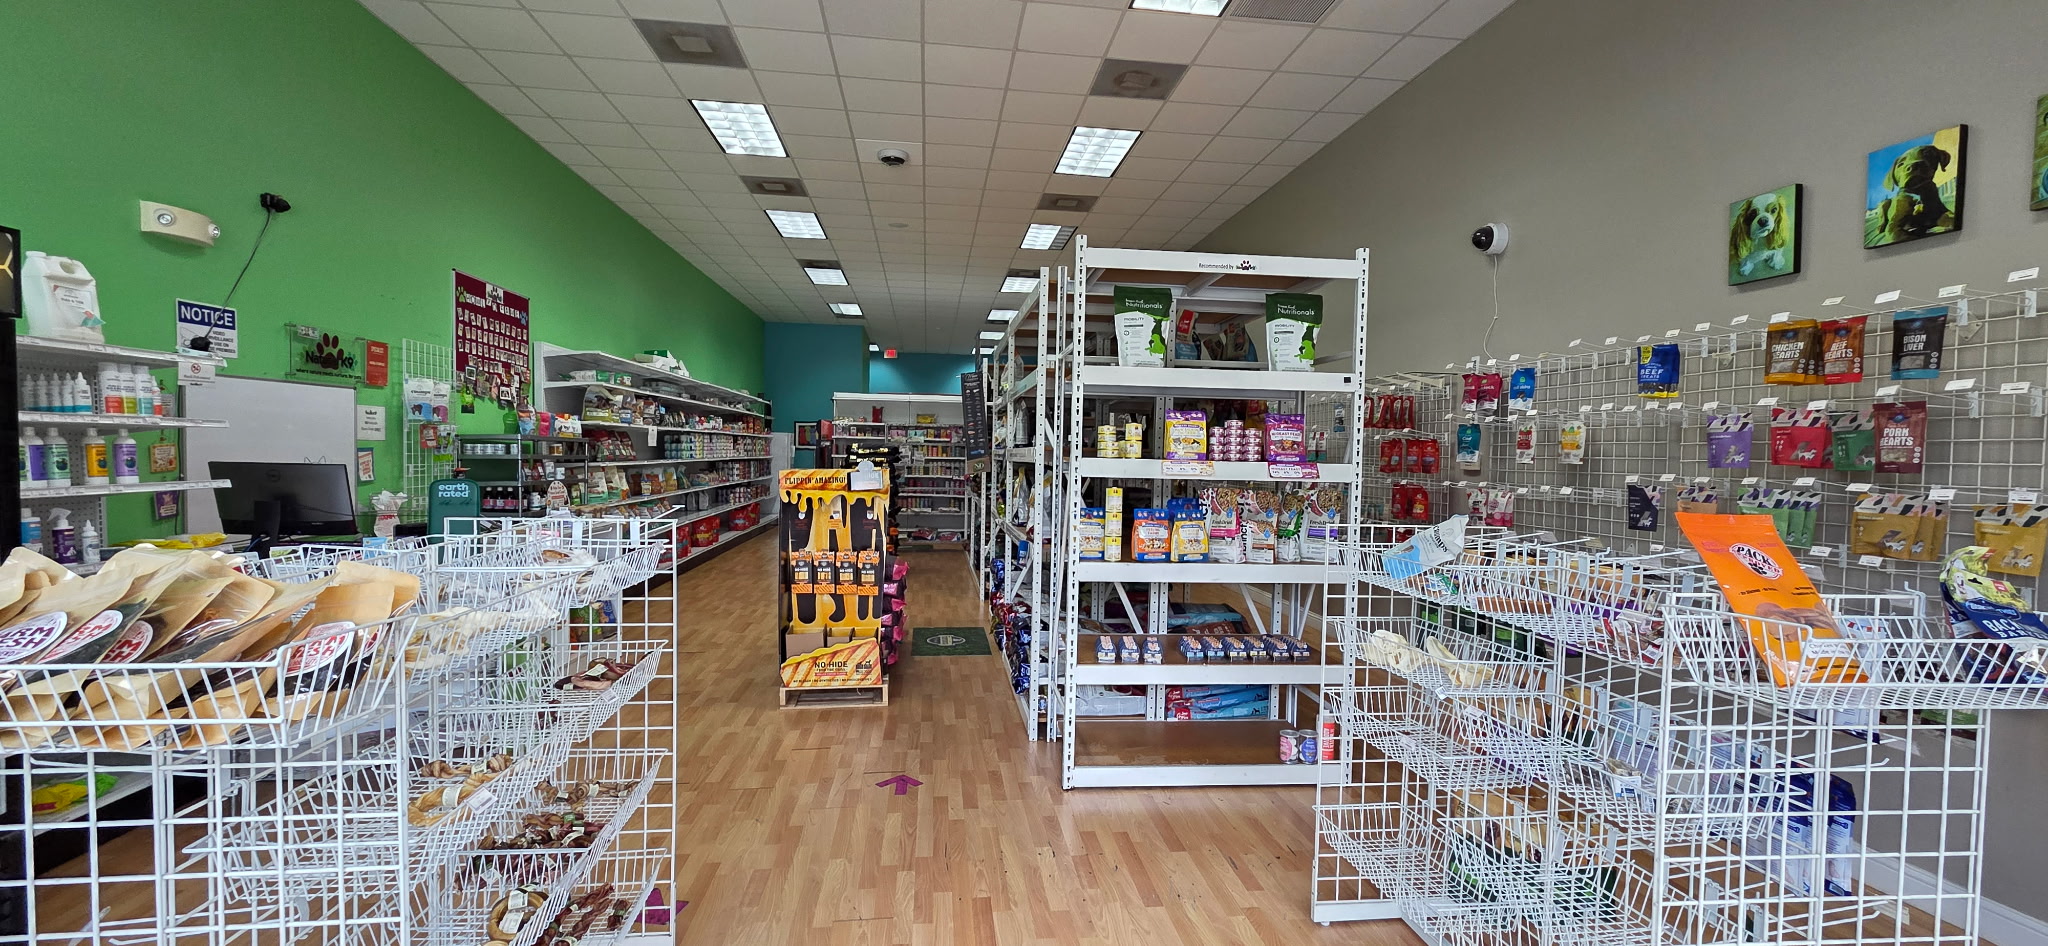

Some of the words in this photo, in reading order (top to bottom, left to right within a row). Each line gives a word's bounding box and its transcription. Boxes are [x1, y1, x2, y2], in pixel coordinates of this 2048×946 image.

[181, 305, 233, 326] NOTICE
[1277, 307, 1315, 316] Nutritionals
[1903, 333, 1926, 344] BISON
[1771, 341, 1805, 353] CHICKEN
[1830, 340, 1848, 352] BEEF
[1903, 341, 1924, 352] LIVER
[1824, 348, 1853, 360] HEARTS
[1883, 427, 1909, 438] PORK
[1879, 436, 1914, 448] HEARTS
[438, 482, 469, 491] earth
[784, 477, 814, 486] FLIPPIN'
[814, 476, 846, 484] AMAZING!
[438, 490, 469, 498] rated
[1736, 546, 1773, 567] PACK
